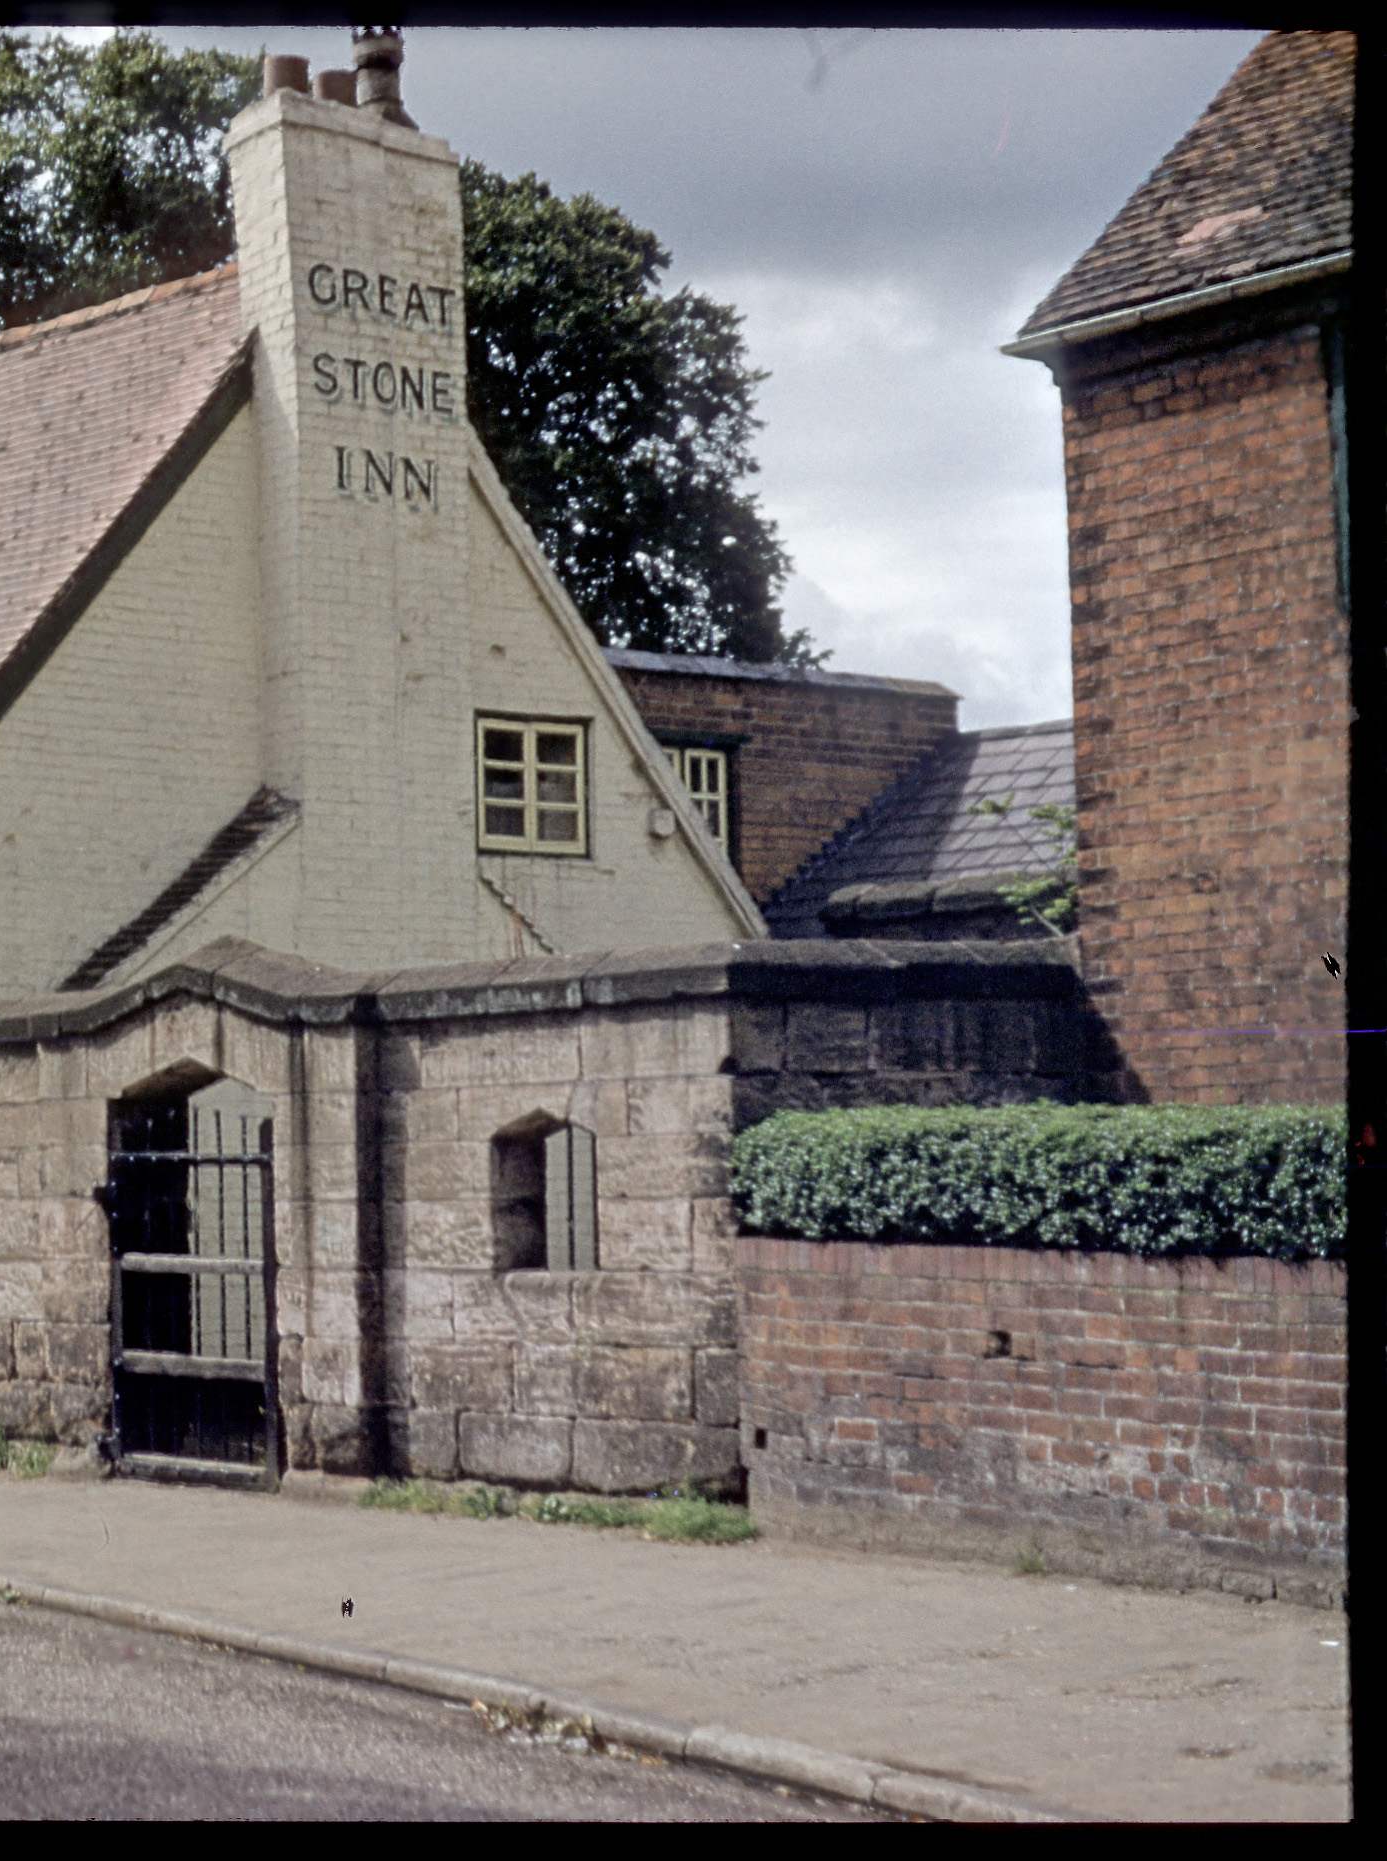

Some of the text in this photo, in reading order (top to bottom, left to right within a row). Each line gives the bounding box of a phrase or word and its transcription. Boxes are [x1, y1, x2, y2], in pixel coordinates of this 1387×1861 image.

[307, 263, 456, 327] GREAT
[312, 353, 454, 415] STONE
[334, 445, 435, 501] INN
